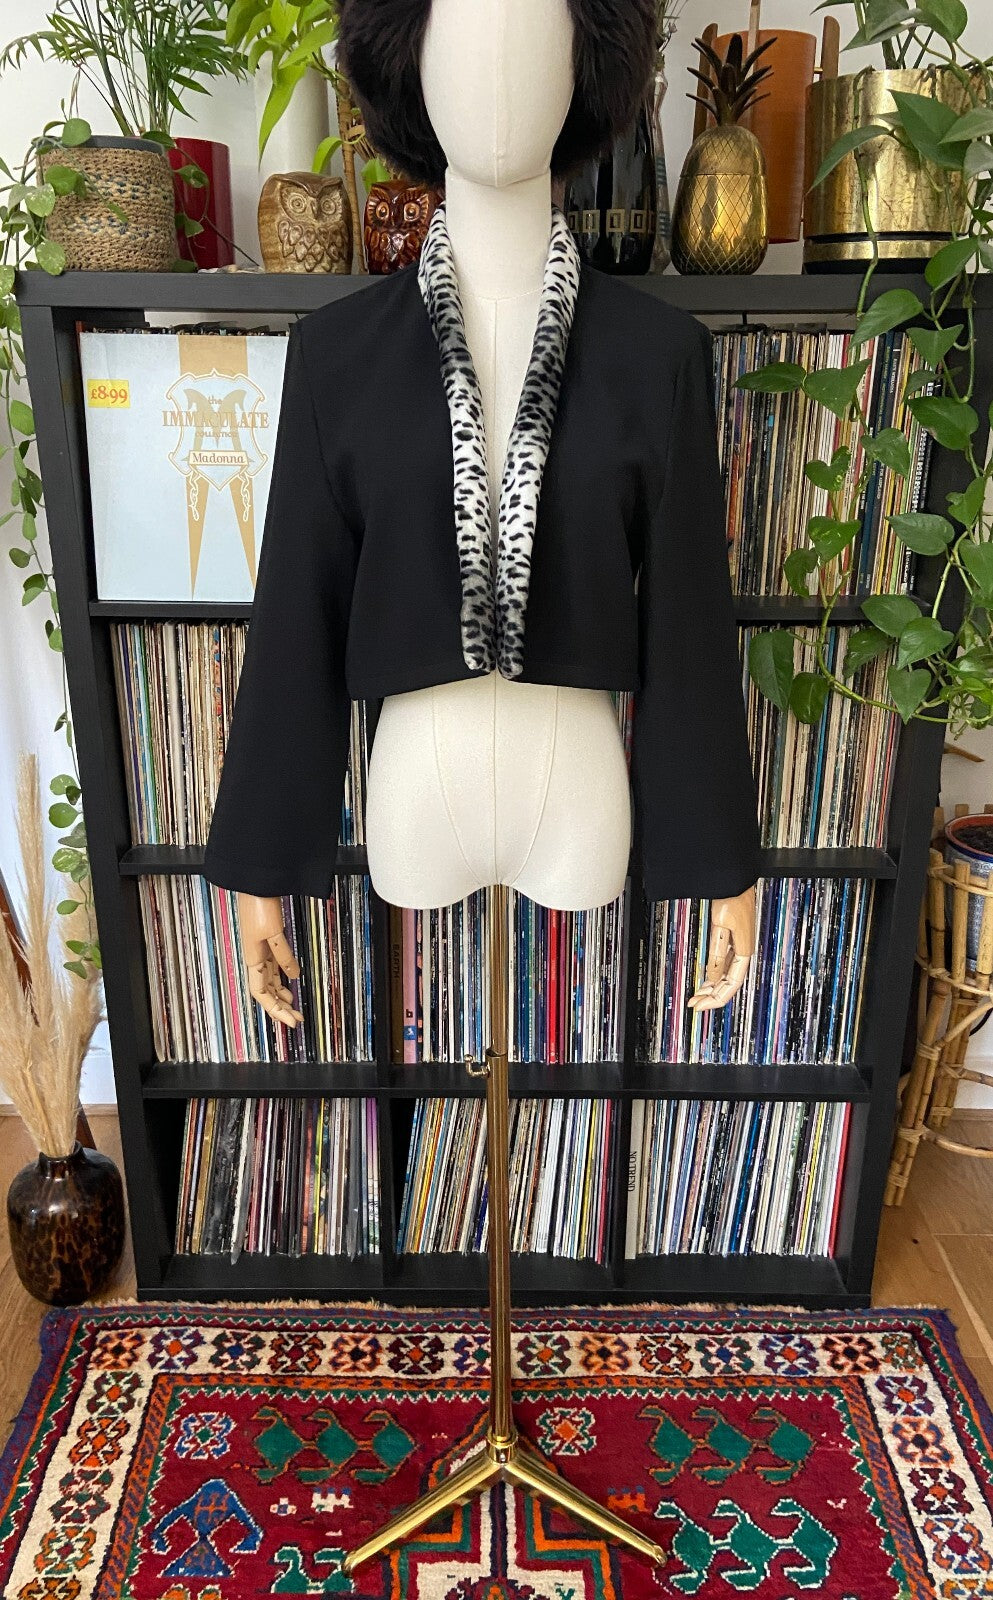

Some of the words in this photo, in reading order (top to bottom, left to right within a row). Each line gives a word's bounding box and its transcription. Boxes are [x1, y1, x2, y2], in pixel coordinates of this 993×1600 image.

[207, 395, 222, 405] the
[162, 410, 269, 428] IMMACULATE
[192, 453, 245, 464] Madonna
